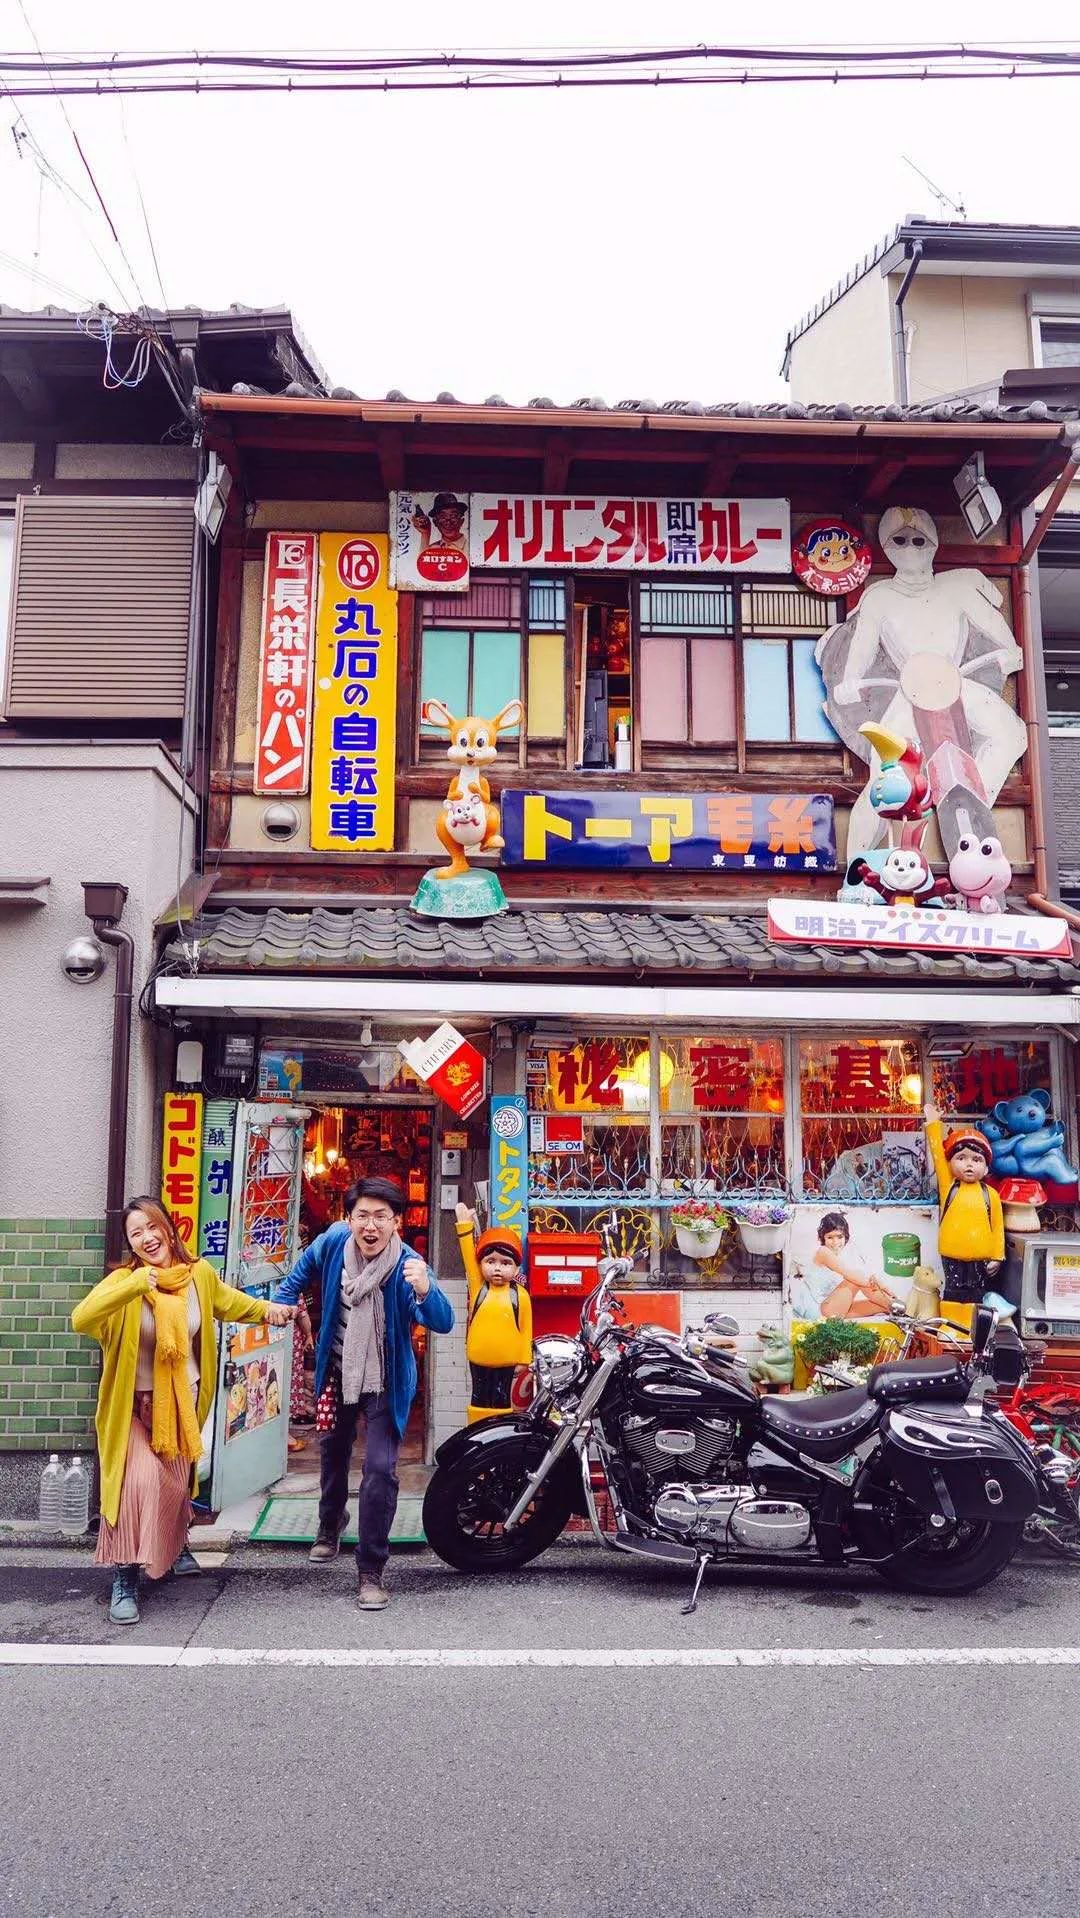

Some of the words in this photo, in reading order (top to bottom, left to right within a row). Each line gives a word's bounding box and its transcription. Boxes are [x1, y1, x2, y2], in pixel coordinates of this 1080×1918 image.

[261, 578, 307, 786] 長栄軒のパン
[328, 597, 382, 841] 丸石の自転車
[794, 915, 1041, 950] 明治アイスクリーム
